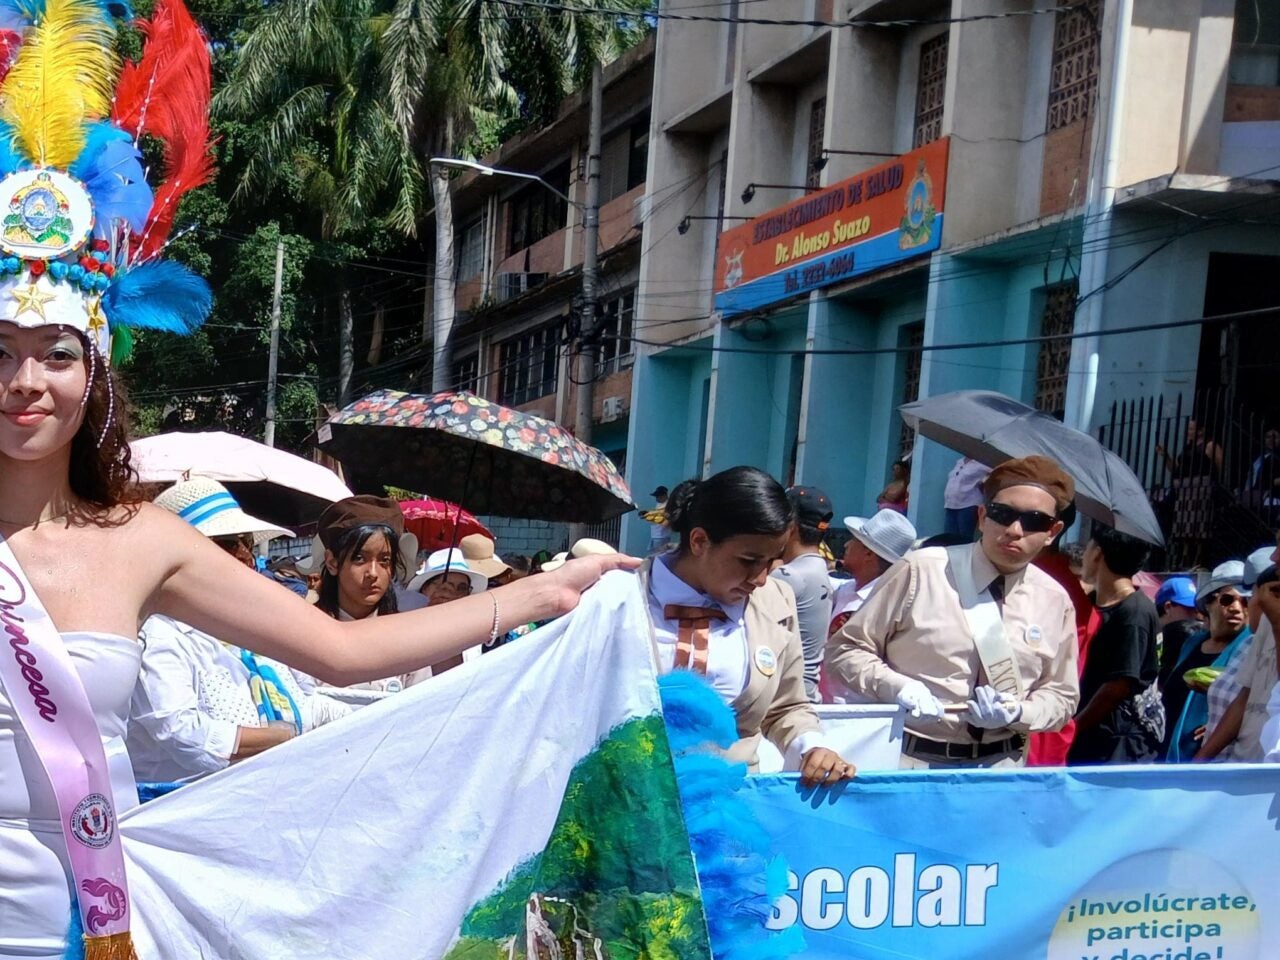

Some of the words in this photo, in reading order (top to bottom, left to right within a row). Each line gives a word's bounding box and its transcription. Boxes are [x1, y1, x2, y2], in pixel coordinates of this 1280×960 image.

[752, 187, 845, 245] ESTABLECIMIENTO
[847, 179, 863, 208] DE
[865, 163, 904, 200] SALUD
[775, 242, 790, 265] Dr.
[791, 232, 830, 261] Alonso
[832, 215, 871, 246] Suazo
[766, 852, 999, 930] scolar
[1068, 892, 1257, 923] ¡Involúcrate,
[1087, 918, 1222, 947] participa
